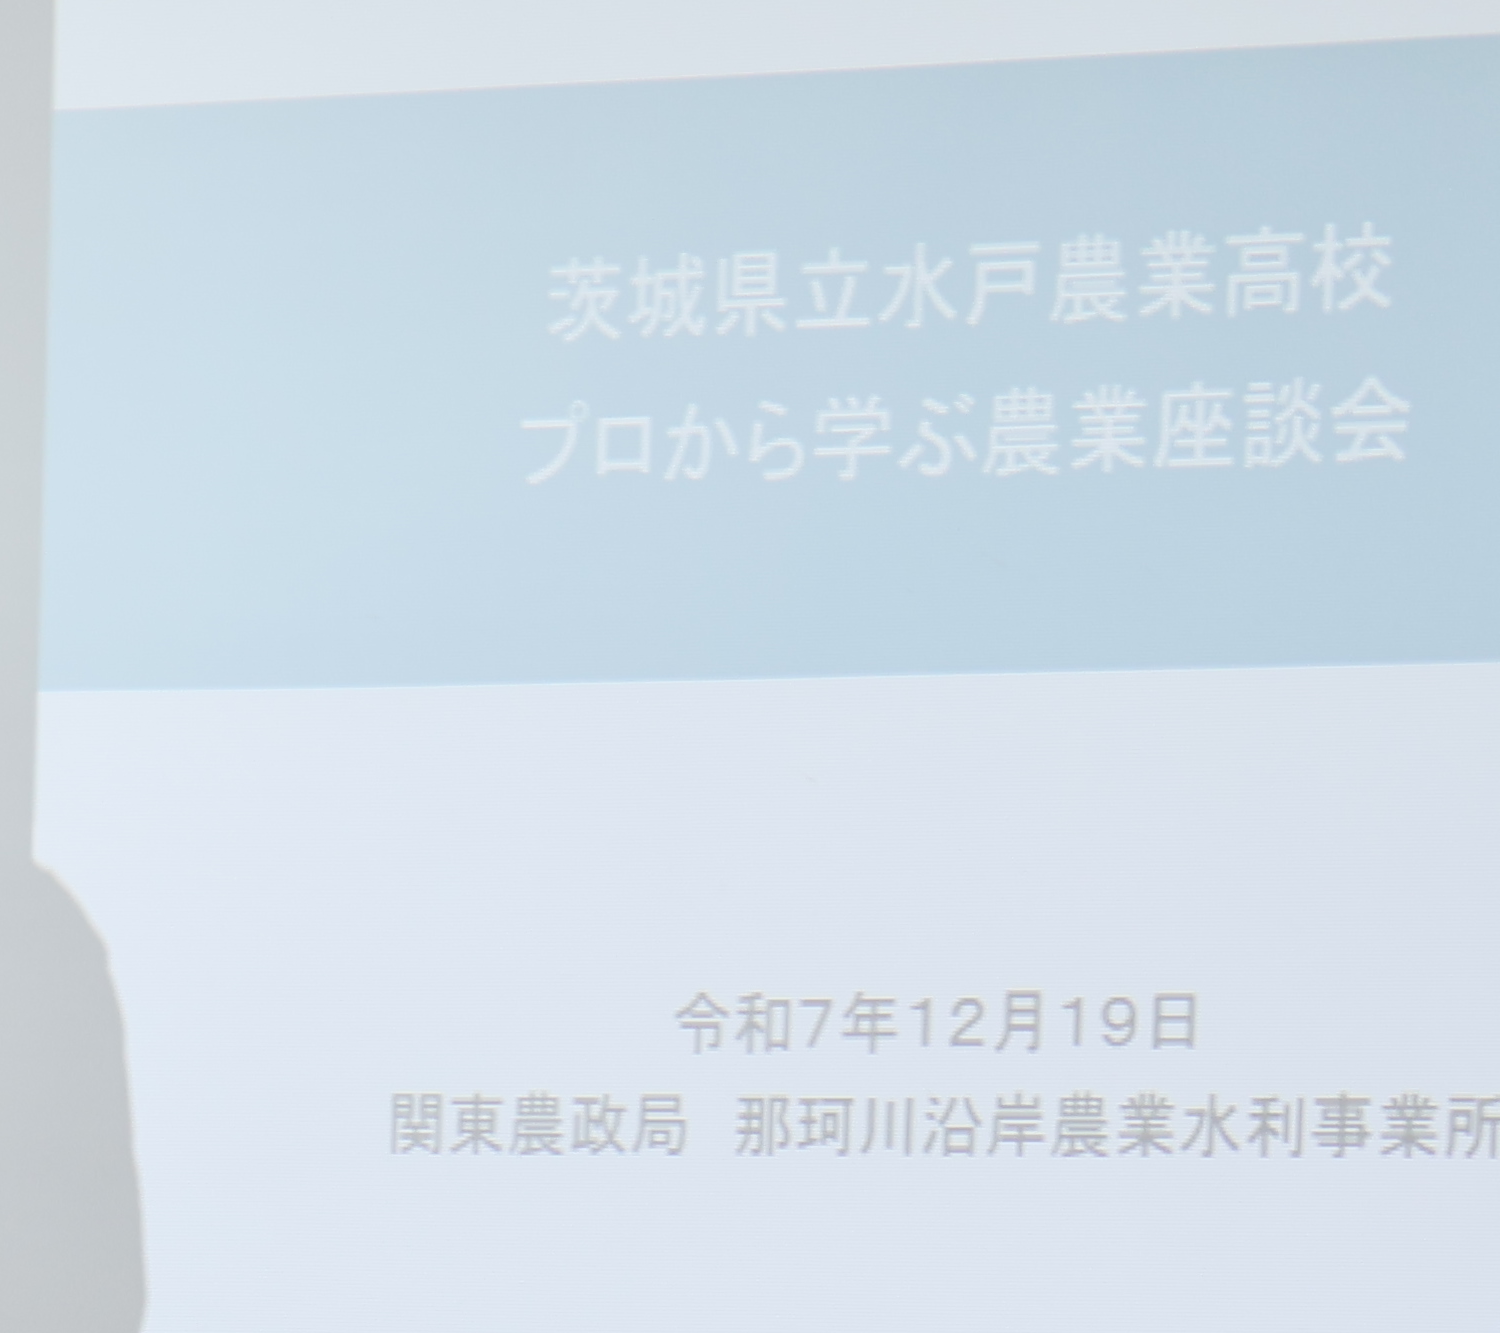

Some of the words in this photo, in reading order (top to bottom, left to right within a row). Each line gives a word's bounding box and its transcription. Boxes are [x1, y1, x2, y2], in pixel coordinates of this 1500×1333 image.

[546, 220, 1396, 342] 茨城県立水戸農業高校
[520, 375, 1412, 485] プロから学ぶ農業座談会
[673, 989, 1201, 1057] 令和7年12月19日
[389, 1091, 689, 1157] 関東農政局
[734, 1091, 1500, 1160] 那珂川沿岸農業水利事業所
